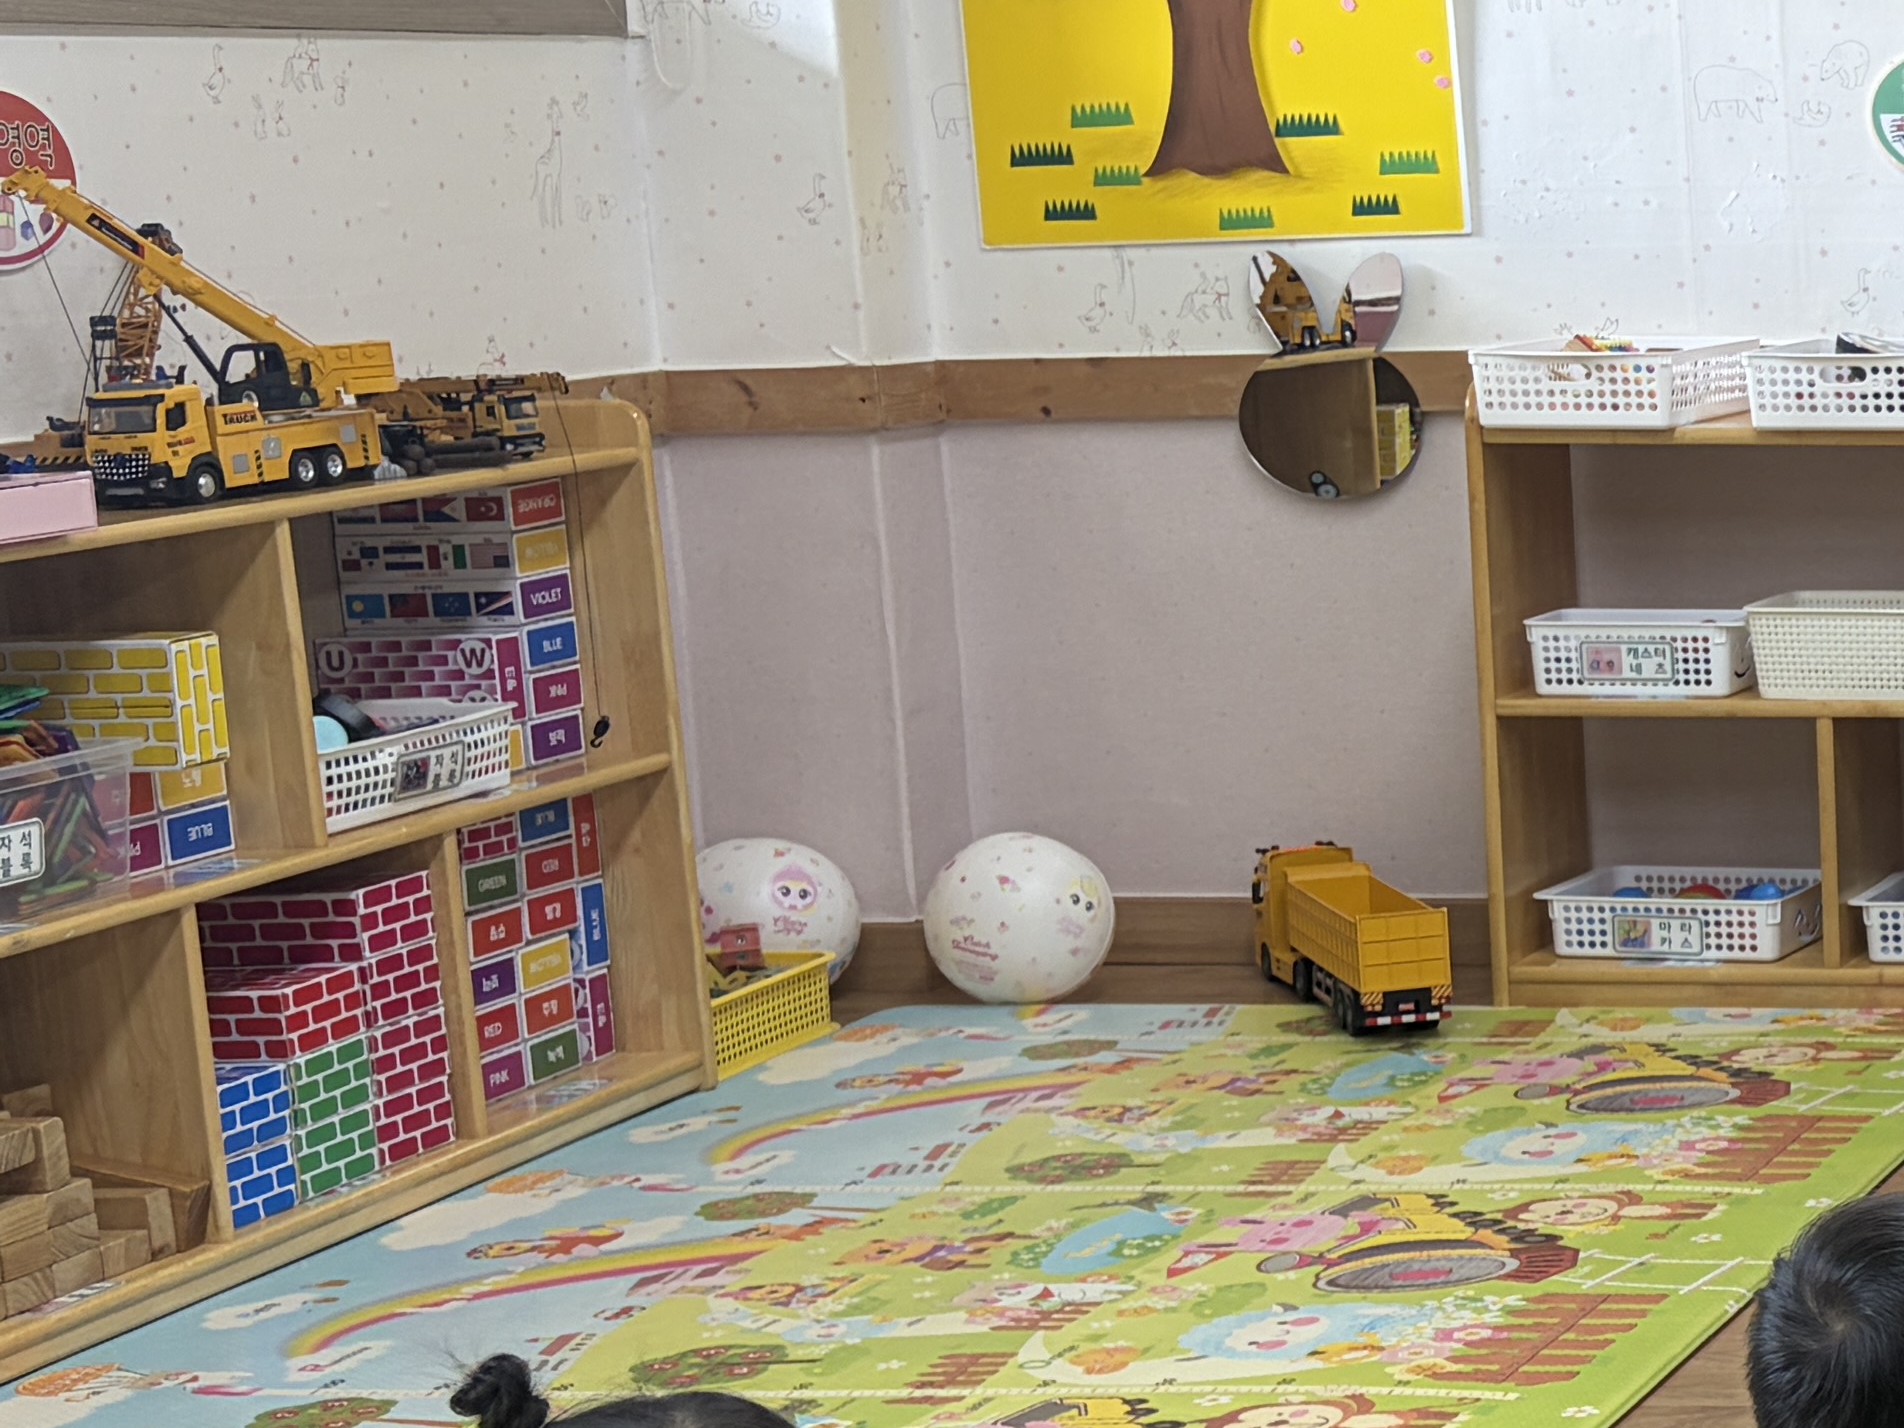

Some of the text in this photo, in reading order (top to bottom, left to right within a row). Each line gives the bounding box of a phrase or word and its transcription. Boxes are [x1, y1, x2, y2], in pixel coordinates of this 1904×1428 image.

[221, 410, 258, 426] TRUCK
[530, 587, 564, 606] VIOLET
[542, 636, 563, 653] BLUE
[325, 648, 344, 673] U
[460, 647, 486, 671] W
[186, 822, 214, 843] BLUE
[477, 874, 507, 893] GREEN
[483, 1020, 503, 1040] RED
[489, 1067, 511, 1088] PINK
